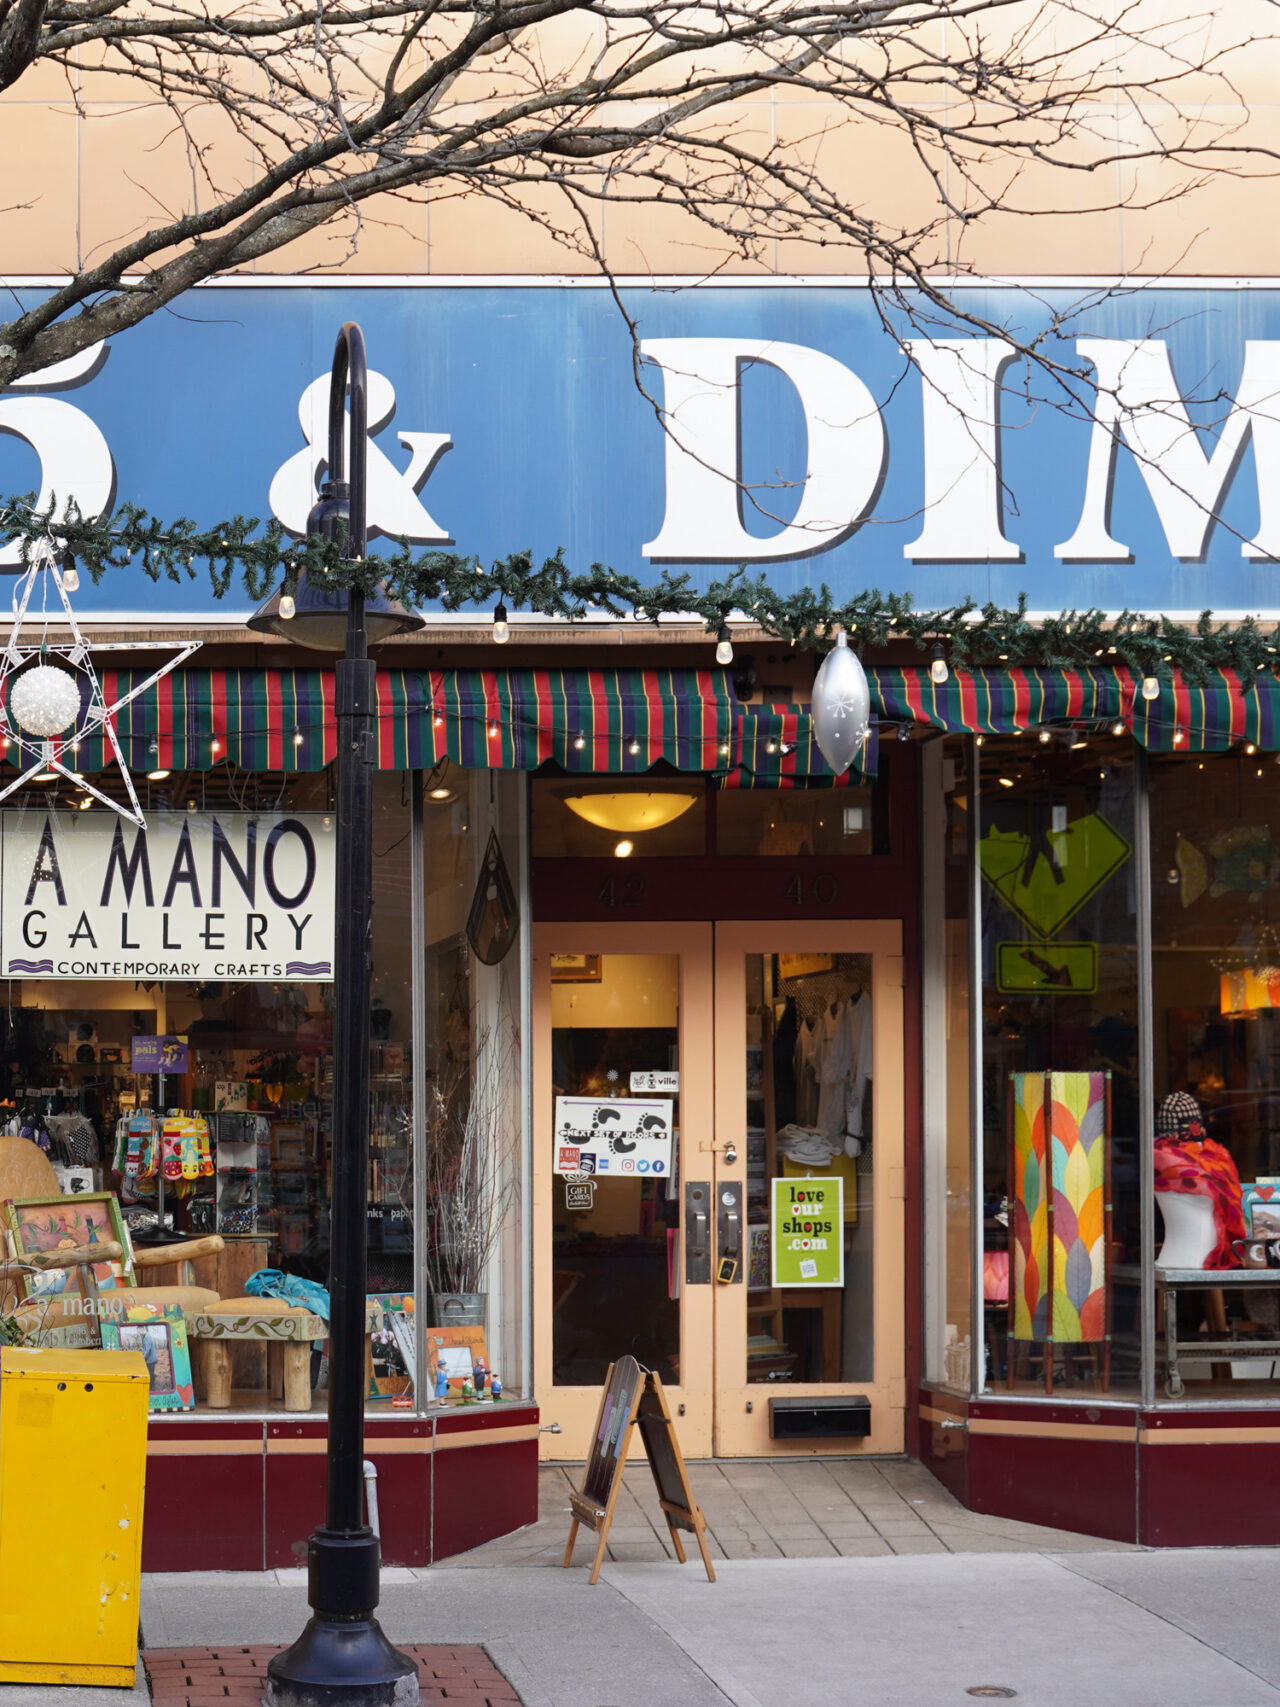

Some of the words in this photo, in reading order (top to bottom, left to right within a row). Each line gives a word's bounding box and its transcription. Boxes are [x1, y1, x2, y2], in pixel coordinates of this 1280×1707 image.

[24, 815, 68, 907] A
[99, 814, 317, 910] MANO
[597, 874, 646, 907] 42
[22, 909, 313, 951] GALLERY
[57, 960, 201, 976] CONTEMPORARY
[213, 962, 283, 977] CRAFTS
[570, 1186, 588, 1195] GIFT
[790, 1186, 825, 1203] love
[791, 1203, 823, 1216] our
[782, 1216, 832, 1237] shops
[787, 1238, 828, 1251] .com
[61, 1296, 124, 1316] mano
